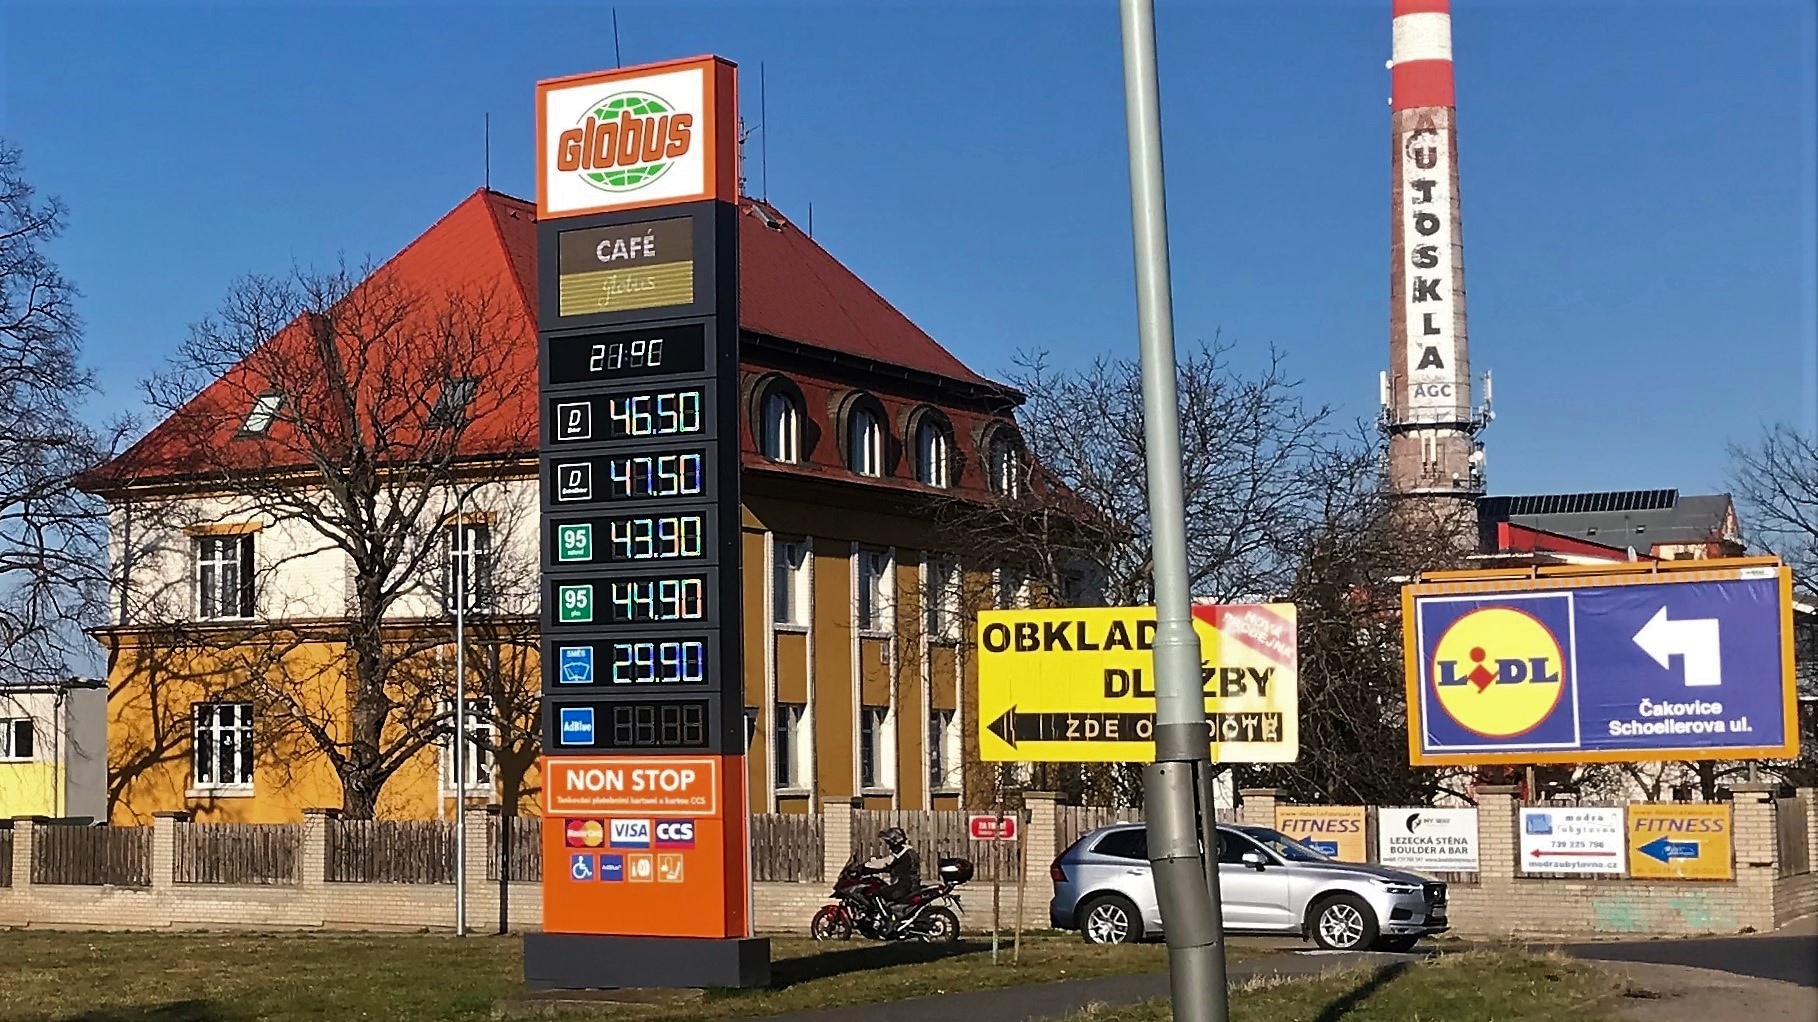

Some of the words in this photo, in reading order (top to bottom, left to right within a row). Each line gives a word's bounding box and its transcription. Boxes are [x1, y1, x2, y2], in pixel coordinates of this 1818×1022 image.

[596, 229, 656, 263] CAFÉ
[1414, 384, 1452, 398] AGC
[568, 409, 582, 427] D
[610, 391, 699, 436] 46.50
[569, 470, 582, 487] D
[610, 453, 700, 497] 47.50
[564, 529, 587, 549] 95
[611, 516, 701, 559] 43.90
[564, 589, 588, 609] 95
[612, 578, 702, 620] 44.90
[982, 620, 1157, 653] OBKLAD
[612, 641, 702, 684] 29.90
[1104, 659, 1276, 698] DLŽBY
[1638, 697, 1723, 717] Čakovice
[563, 720, 592, 732] AdBlue
[1066, 719, 1120, 738] ZDE
[1608, 717, 1725, 736] Schoellerova
[1729, 716, 1753, 733] ul.
[566, 769, 624, 791] NON
[631, 769, 696, 791] STOP
[614, 823, 648, 837] VISA
[656, 823, 694, 840] CCS
[1281, 819, 1361, 833] FITNESS
[1634, 818, 1725, 833] FITNESS
[1390, 836, 1433, 845] LEZECKÁ
[1435, 836, 1468, 845] STĚNA
[1390, 846, 1437, 854] BOULDER
[1439, 846, 1446, 854] A
[1448, 846, 1468, 855] BAR
